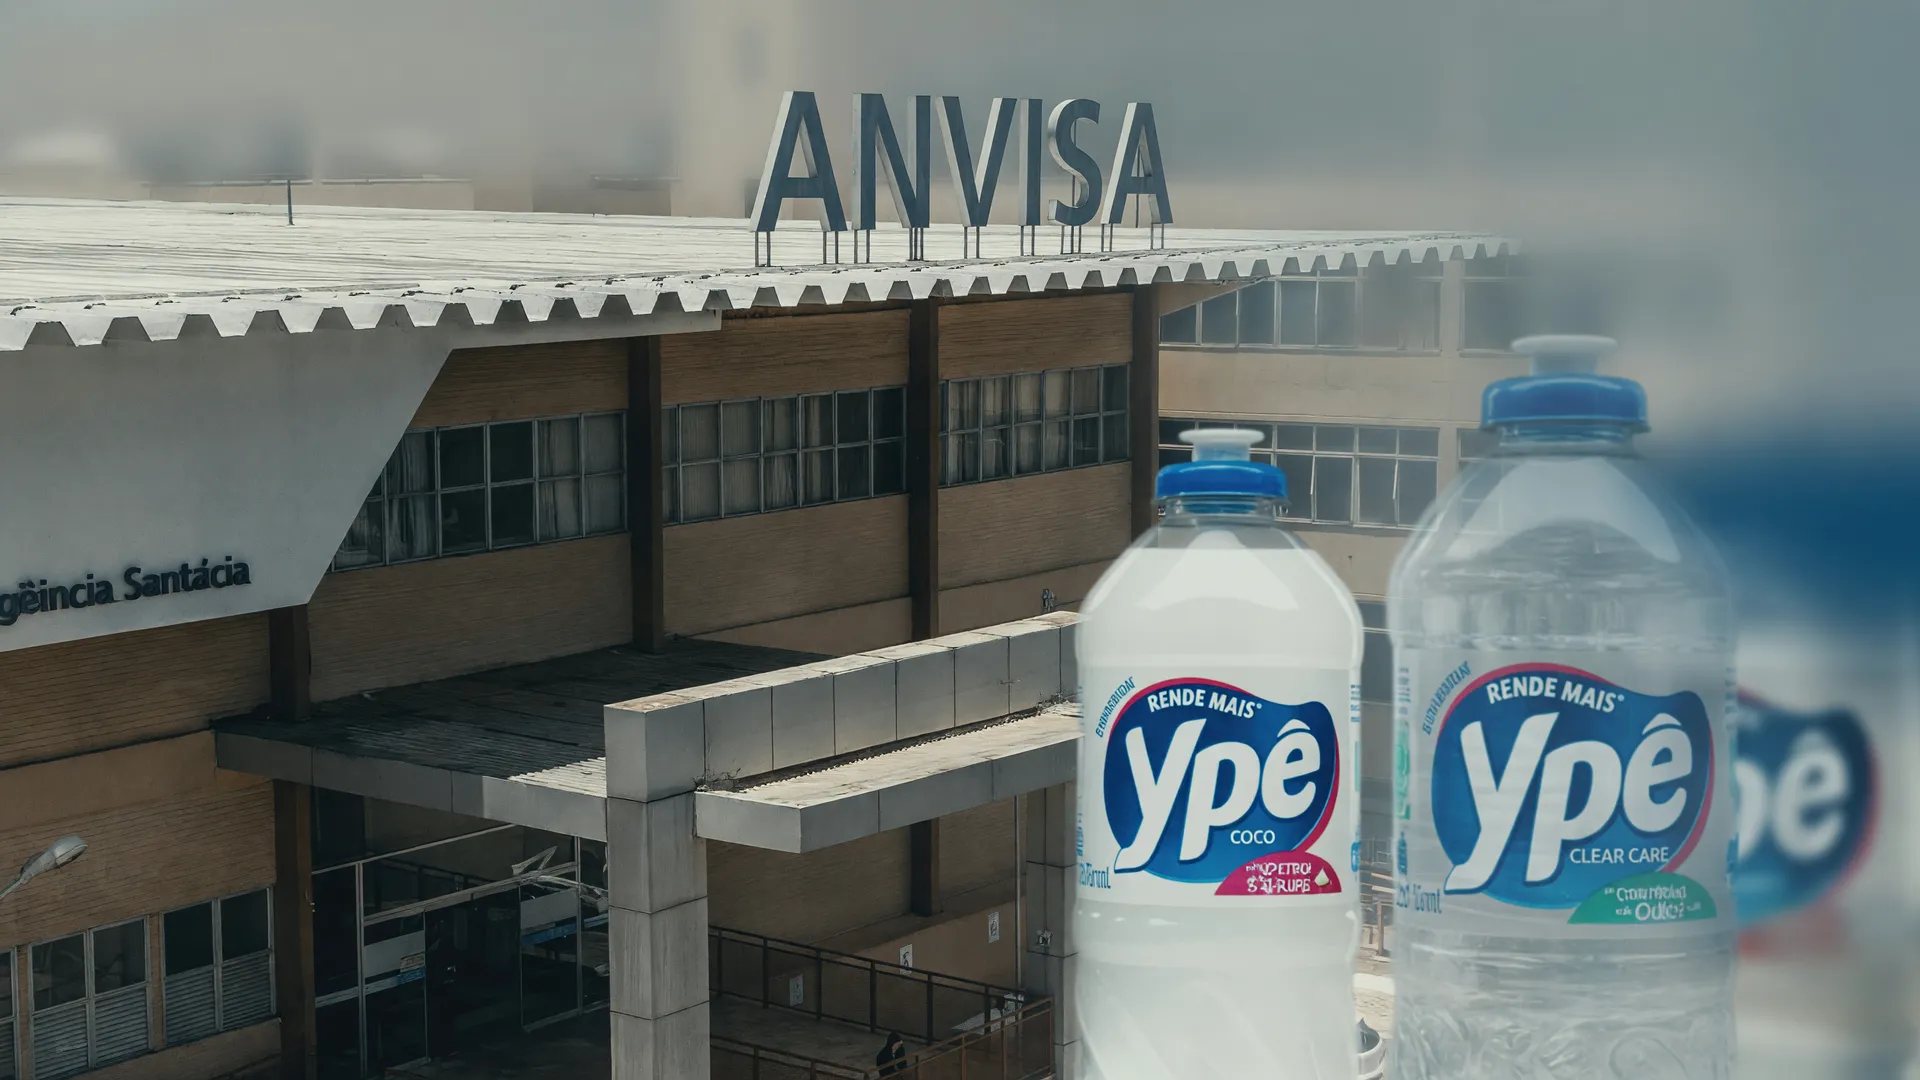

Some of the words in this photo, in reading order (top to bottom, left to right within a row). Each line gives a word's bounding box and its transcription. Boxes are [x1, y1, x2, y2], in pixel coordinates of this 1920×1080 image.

[747, 90, 1174, 232] ANVISA
[123, 555, 252, 601] Santácia
[1147, 688, 1206, 713] RENDE
[1486, 676, 1558, 704] RENDE
[1230, 829, 1276, 845] COCO
[1569, 848, 1624, 864] CLEAR
[1628, 847, 1669, 863] CARE
